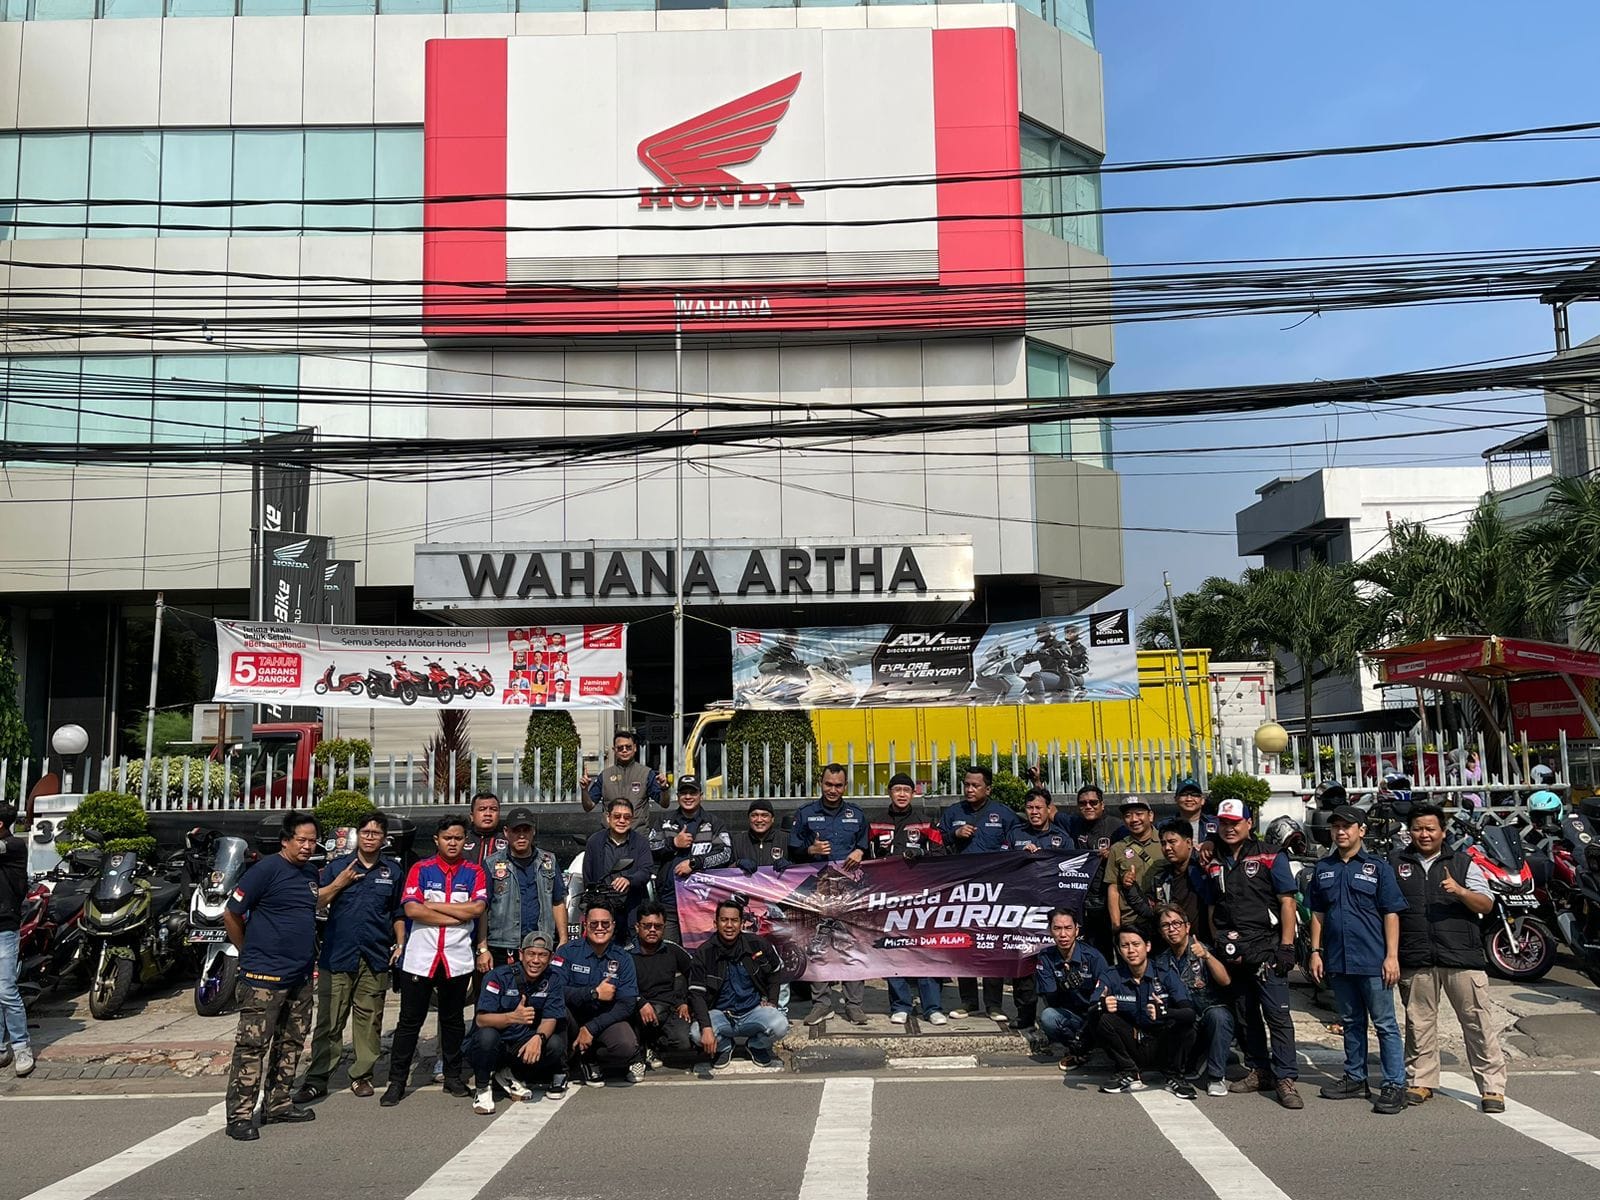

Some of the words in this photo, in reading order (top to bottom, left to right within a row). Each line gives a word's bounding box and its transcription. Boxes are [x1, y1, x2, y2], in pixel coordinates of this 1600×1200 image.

[638, 183, 804, 208] HONDA
[674, 297, 772, 319] WAHANA
[272, 560, 309, 569] HONDA
[459, 549, 719, 597] WAHANA
[737, 546, 928, 593] ARTHA
[330, 628, 370, 636] Garansi
[436, 629, 443, 637] 5
[341, 638, 372, 646] Semua
[374, 638, 407, 648] Sepeda
[408, 639, 436, 647] Motor
[437, 639, 467, 648] Honda
[258, 656, 298, 667] TAHUN
[235, 655, 257, 683] 5
[258, 667, 298, 675] GARANSI
[879, 662, 932, 672] EXPLORE
[903, 667, 966, 678] EVERYDAY
[257, 675, 296, 683] RANGKA
[1058, 881, 1070, 889] One
[868, 888, 940, 911] Honda
[948, 883, 1004, 903] ADV
[883, 905, 1055, 932] NYORIDE
[920, 937, 938, 946] DUA
[940, 936, 966, 945] ALAM
